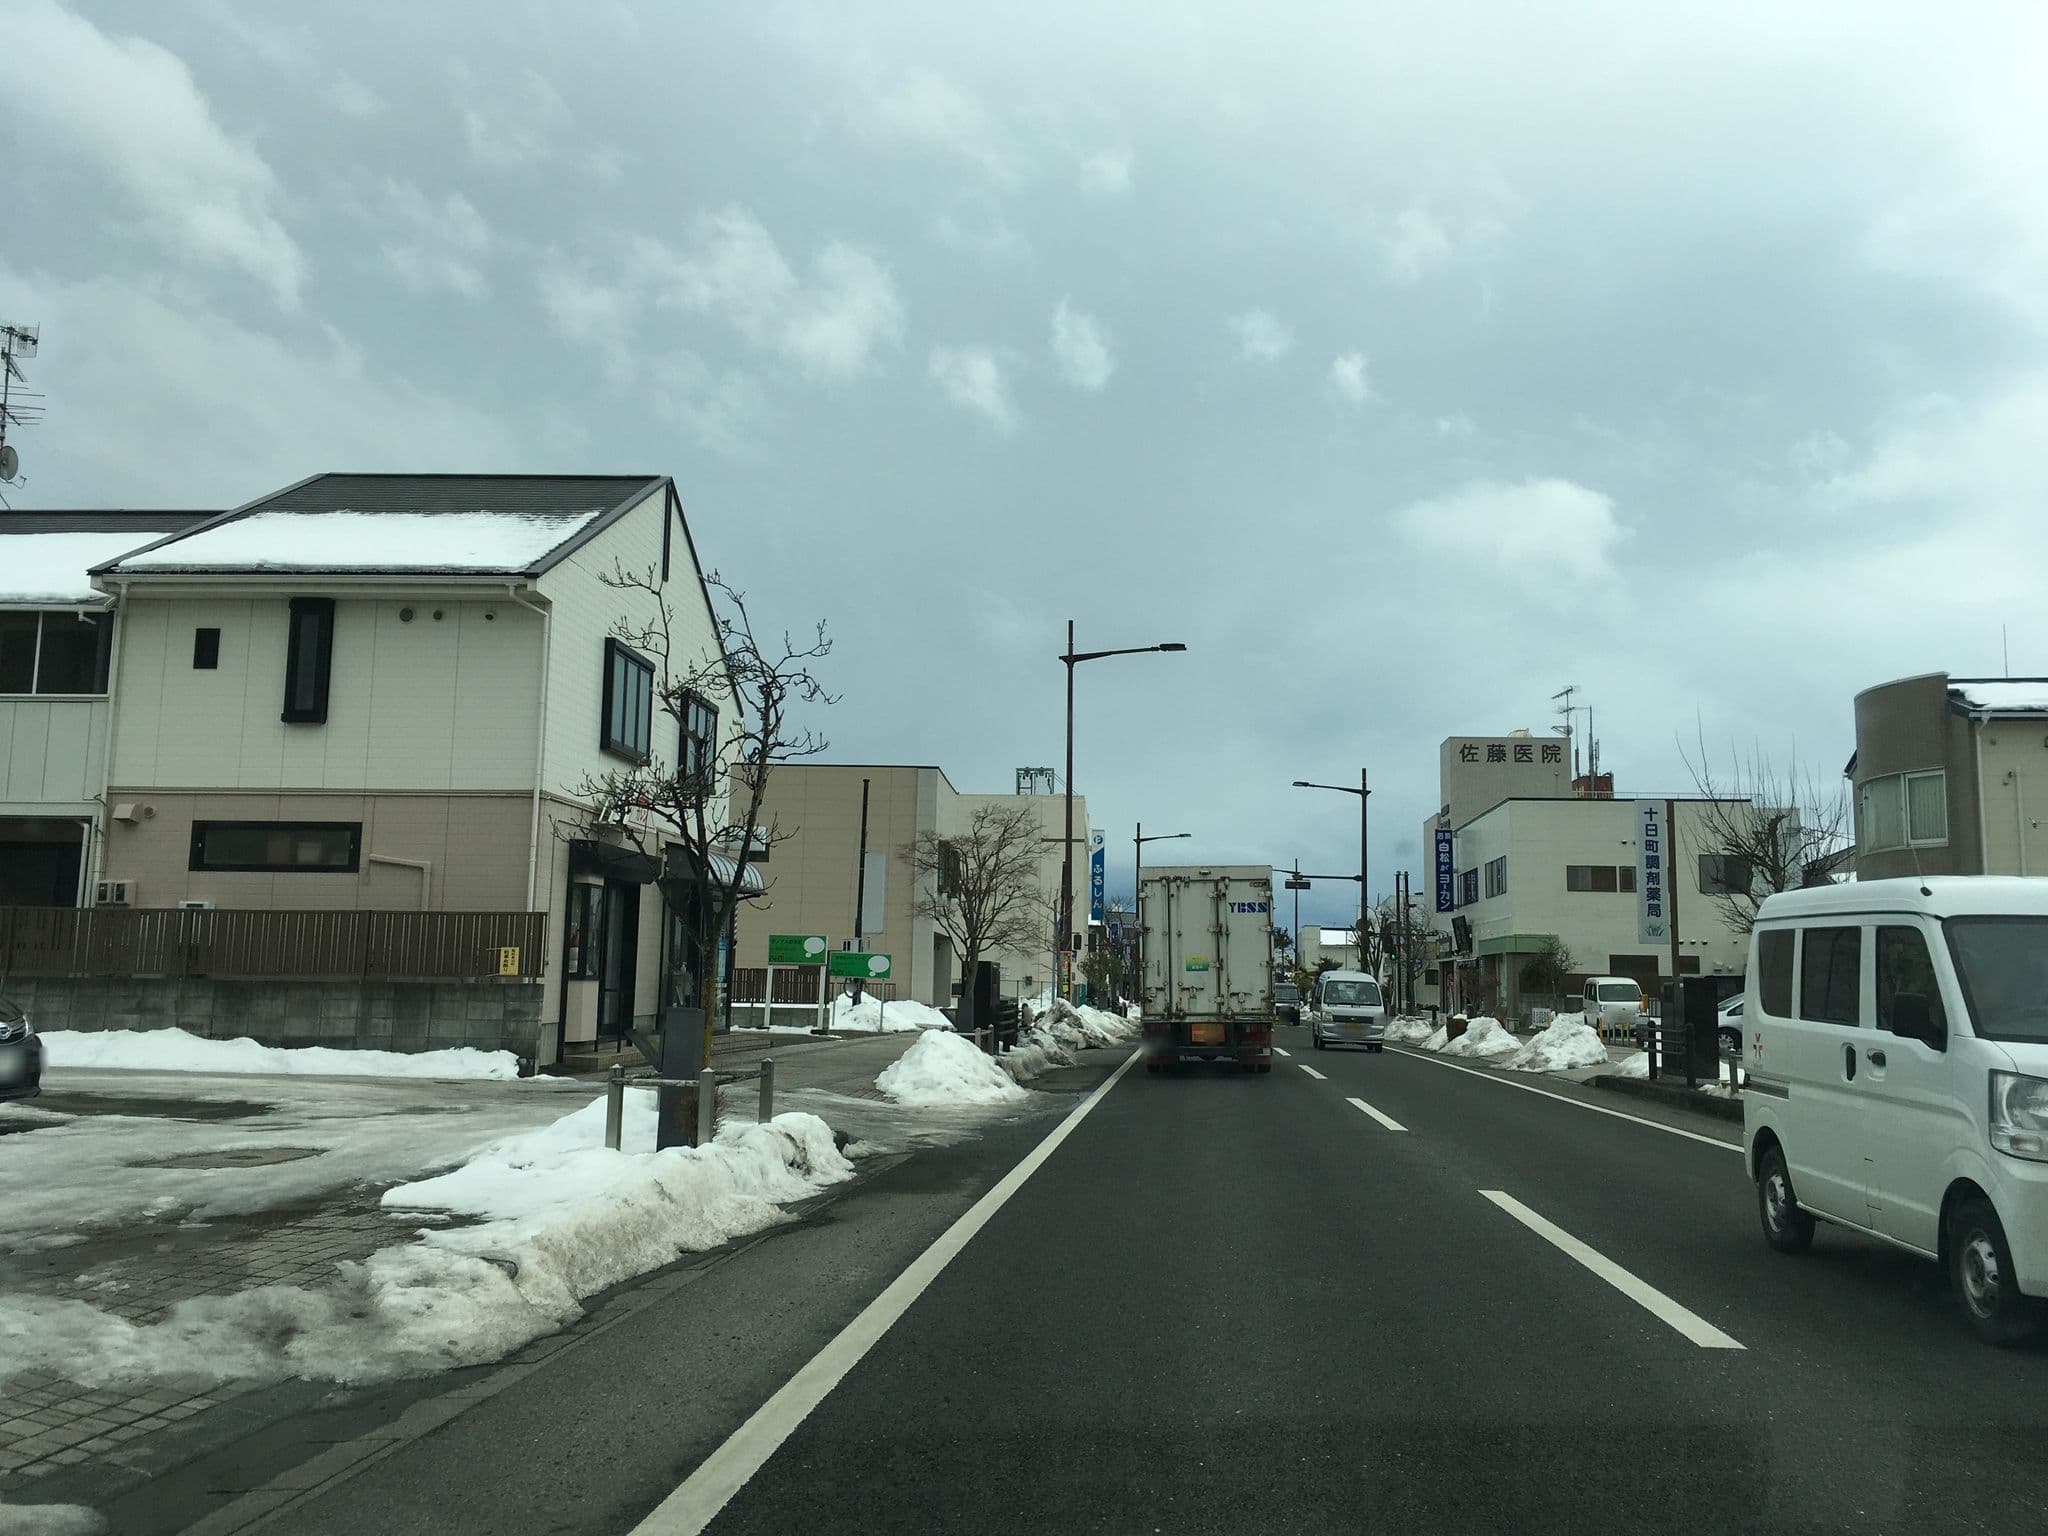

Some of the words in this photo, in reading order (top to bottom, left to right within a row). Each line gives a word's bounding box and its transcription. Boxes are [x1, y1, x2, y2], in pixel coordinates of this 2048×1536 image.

[1459, 743, 1562, 763] 佐藤医院
[1643, 807, 1662, 918] 十日町調剤薬局
[1093, 864, 1103, 909] ふるしん
